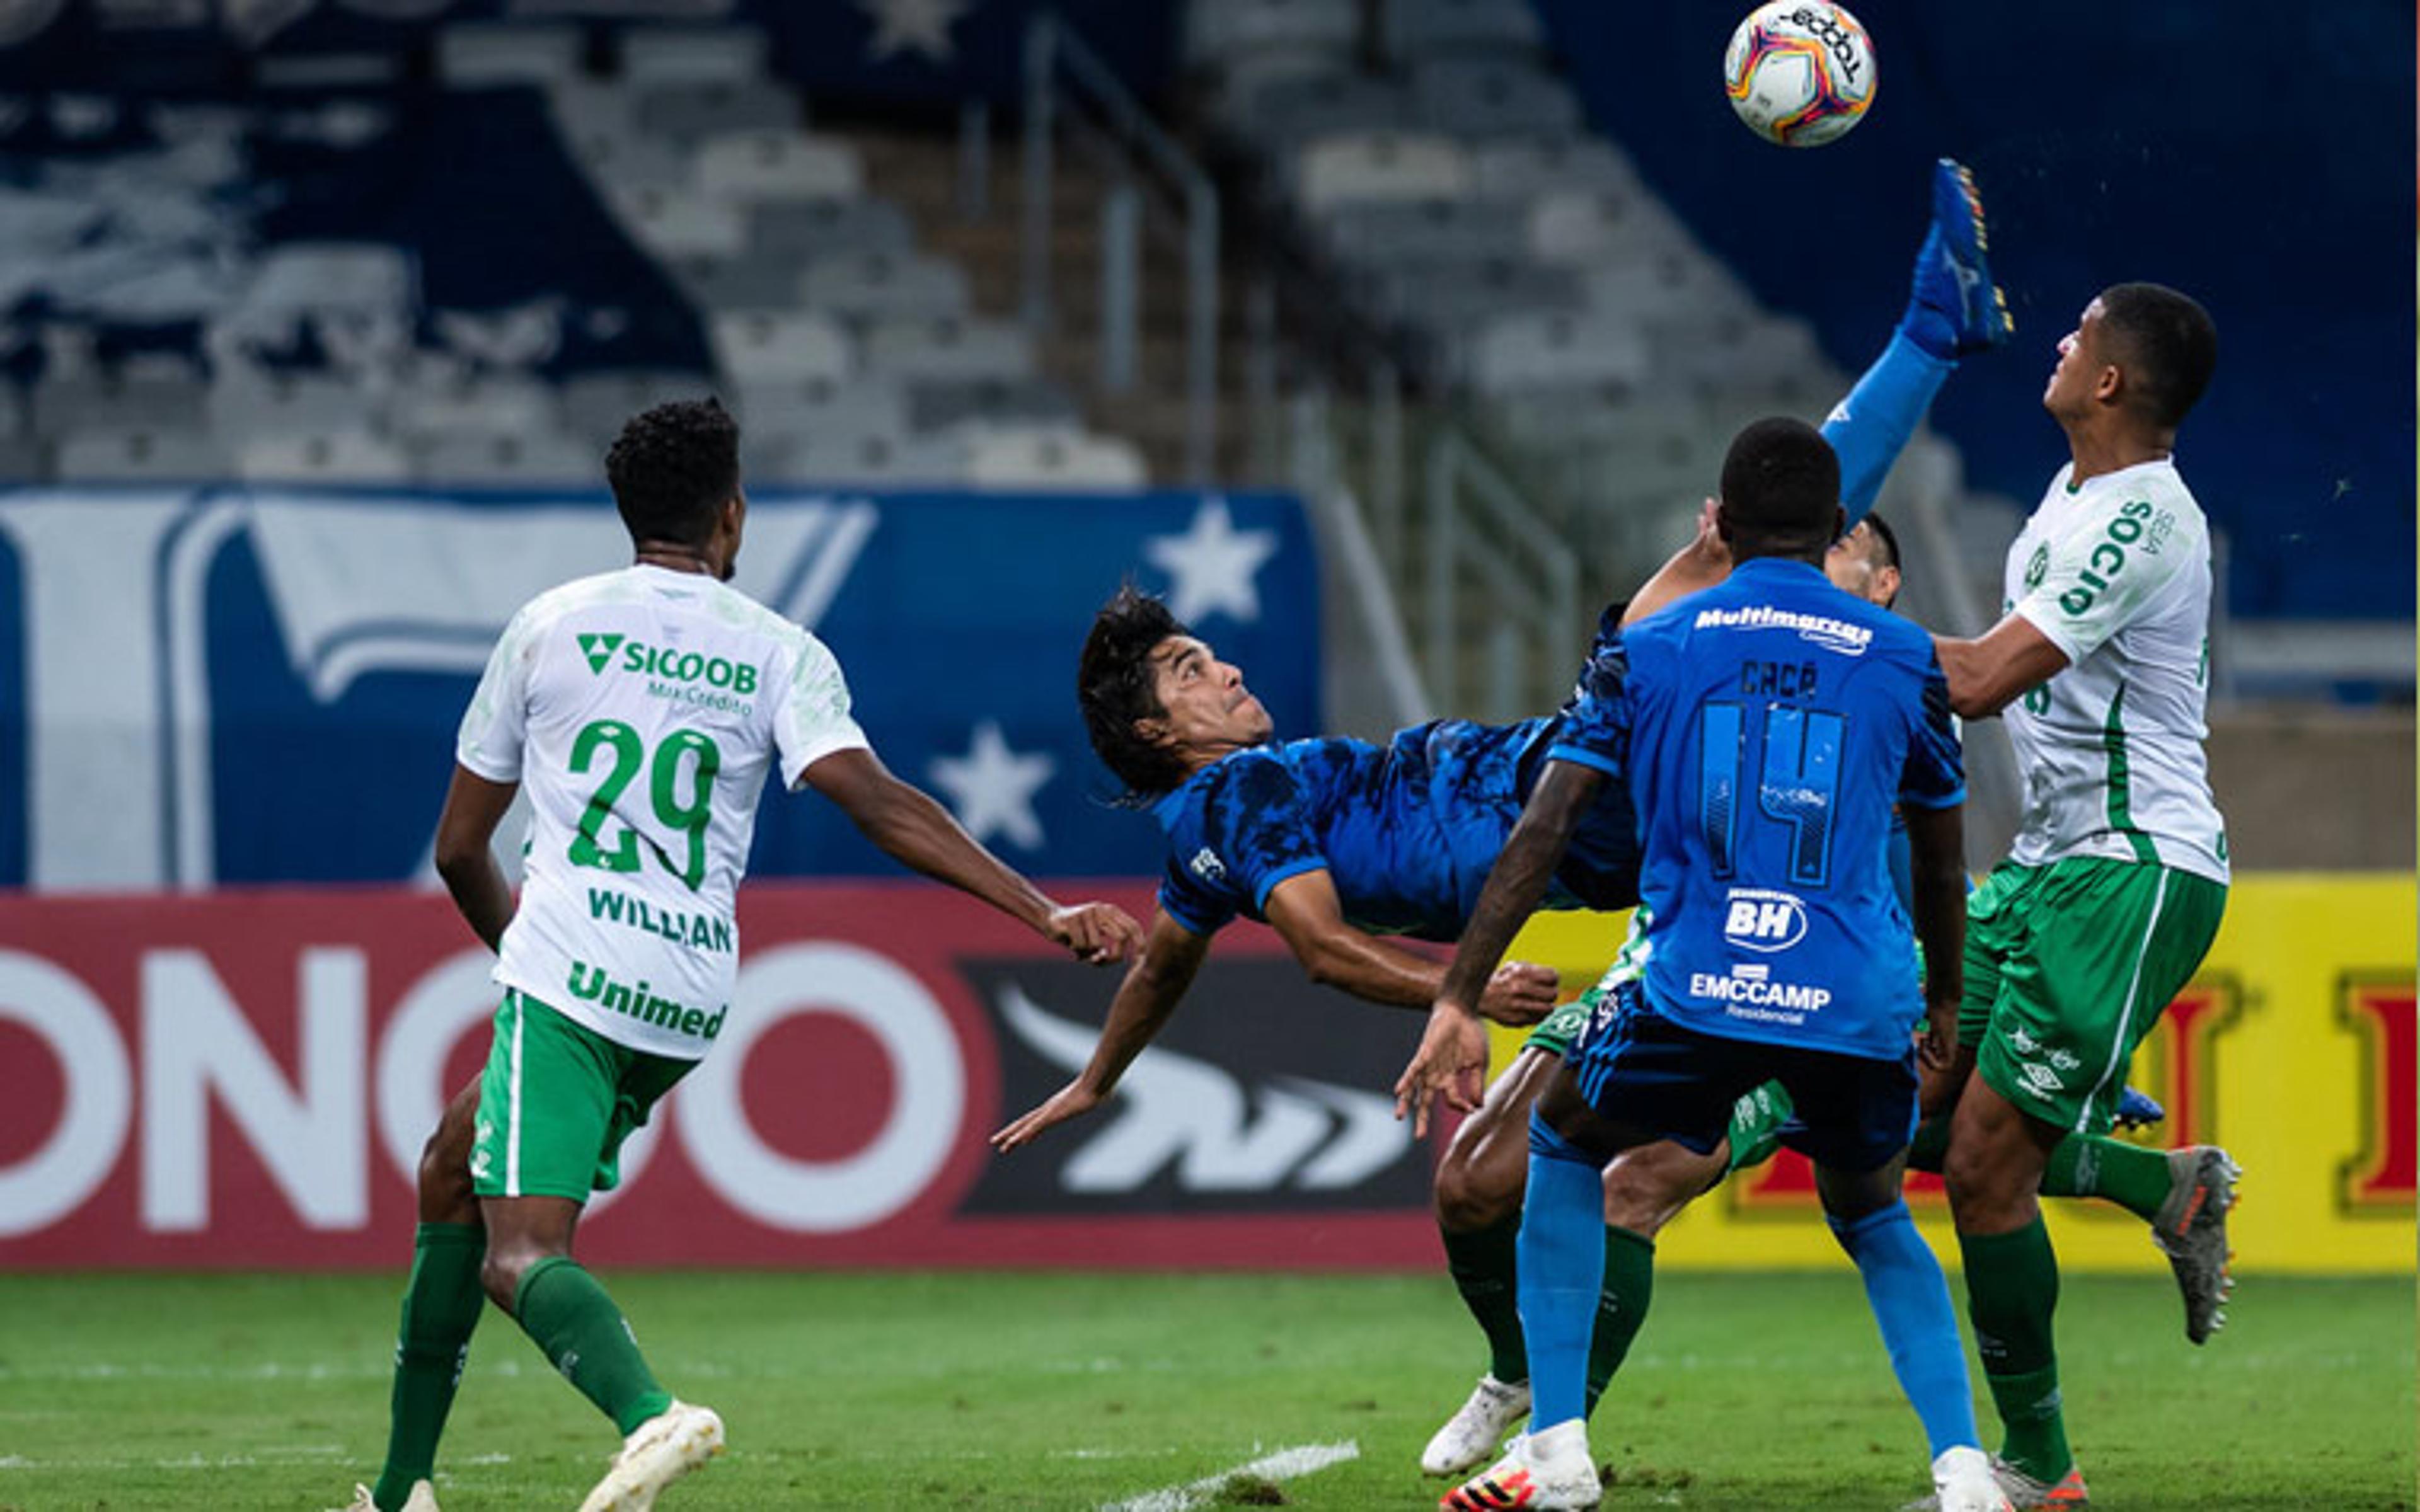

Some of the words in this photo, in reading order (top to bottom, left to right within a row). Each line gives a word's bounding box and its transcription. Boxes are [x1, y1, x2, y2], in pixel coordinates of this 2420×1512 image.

[1695, 607, 1873, 644] Multimarcas
[623, 642, 758, 694] SICOOB
[569, 718, 720, 892] 29
[1702, 701, 1848, 889] 14
[588, 888, 732, 953] WILLIAN
[1725, 900, 1792, 938] BH
[568, 959, 727, 1040] Unimed
[1690, 973, 1831, 1011] EMCCAMP
